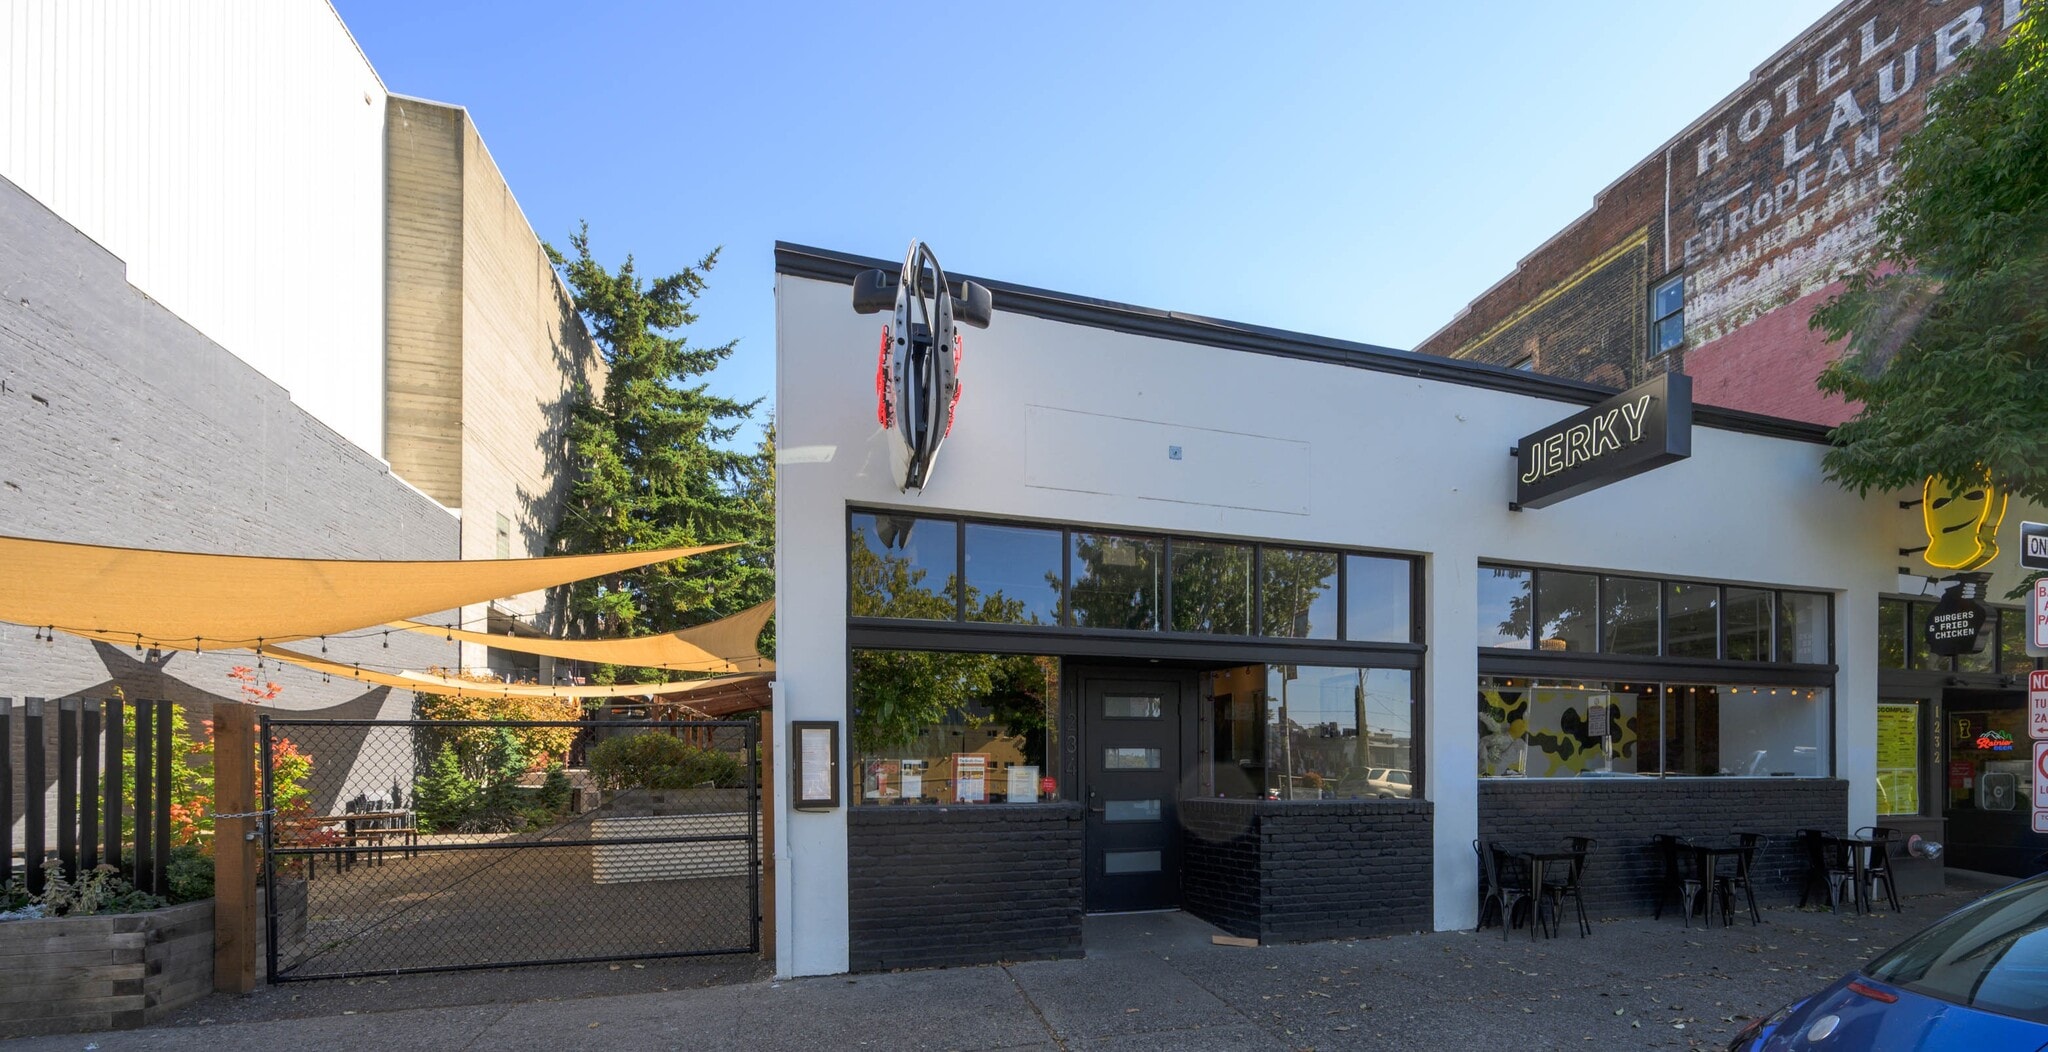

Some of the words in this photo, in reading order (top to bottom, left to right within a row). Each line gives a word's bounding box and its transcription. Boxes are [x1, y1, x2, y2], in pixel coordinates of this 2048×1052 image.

[1697, 15, 1899, 176] HOTEL
[1684, 123, 1880, 268] EUROPEAN
[1521, 394, 1650, 484] JERKY
[1934, 611, 1974, 623] BURGERS
[1940, 620, 1969, 631] FRIED
[1935, 628, 1975, 640] CHICKEN
[1976, 737, 2013, 749] Rainier
